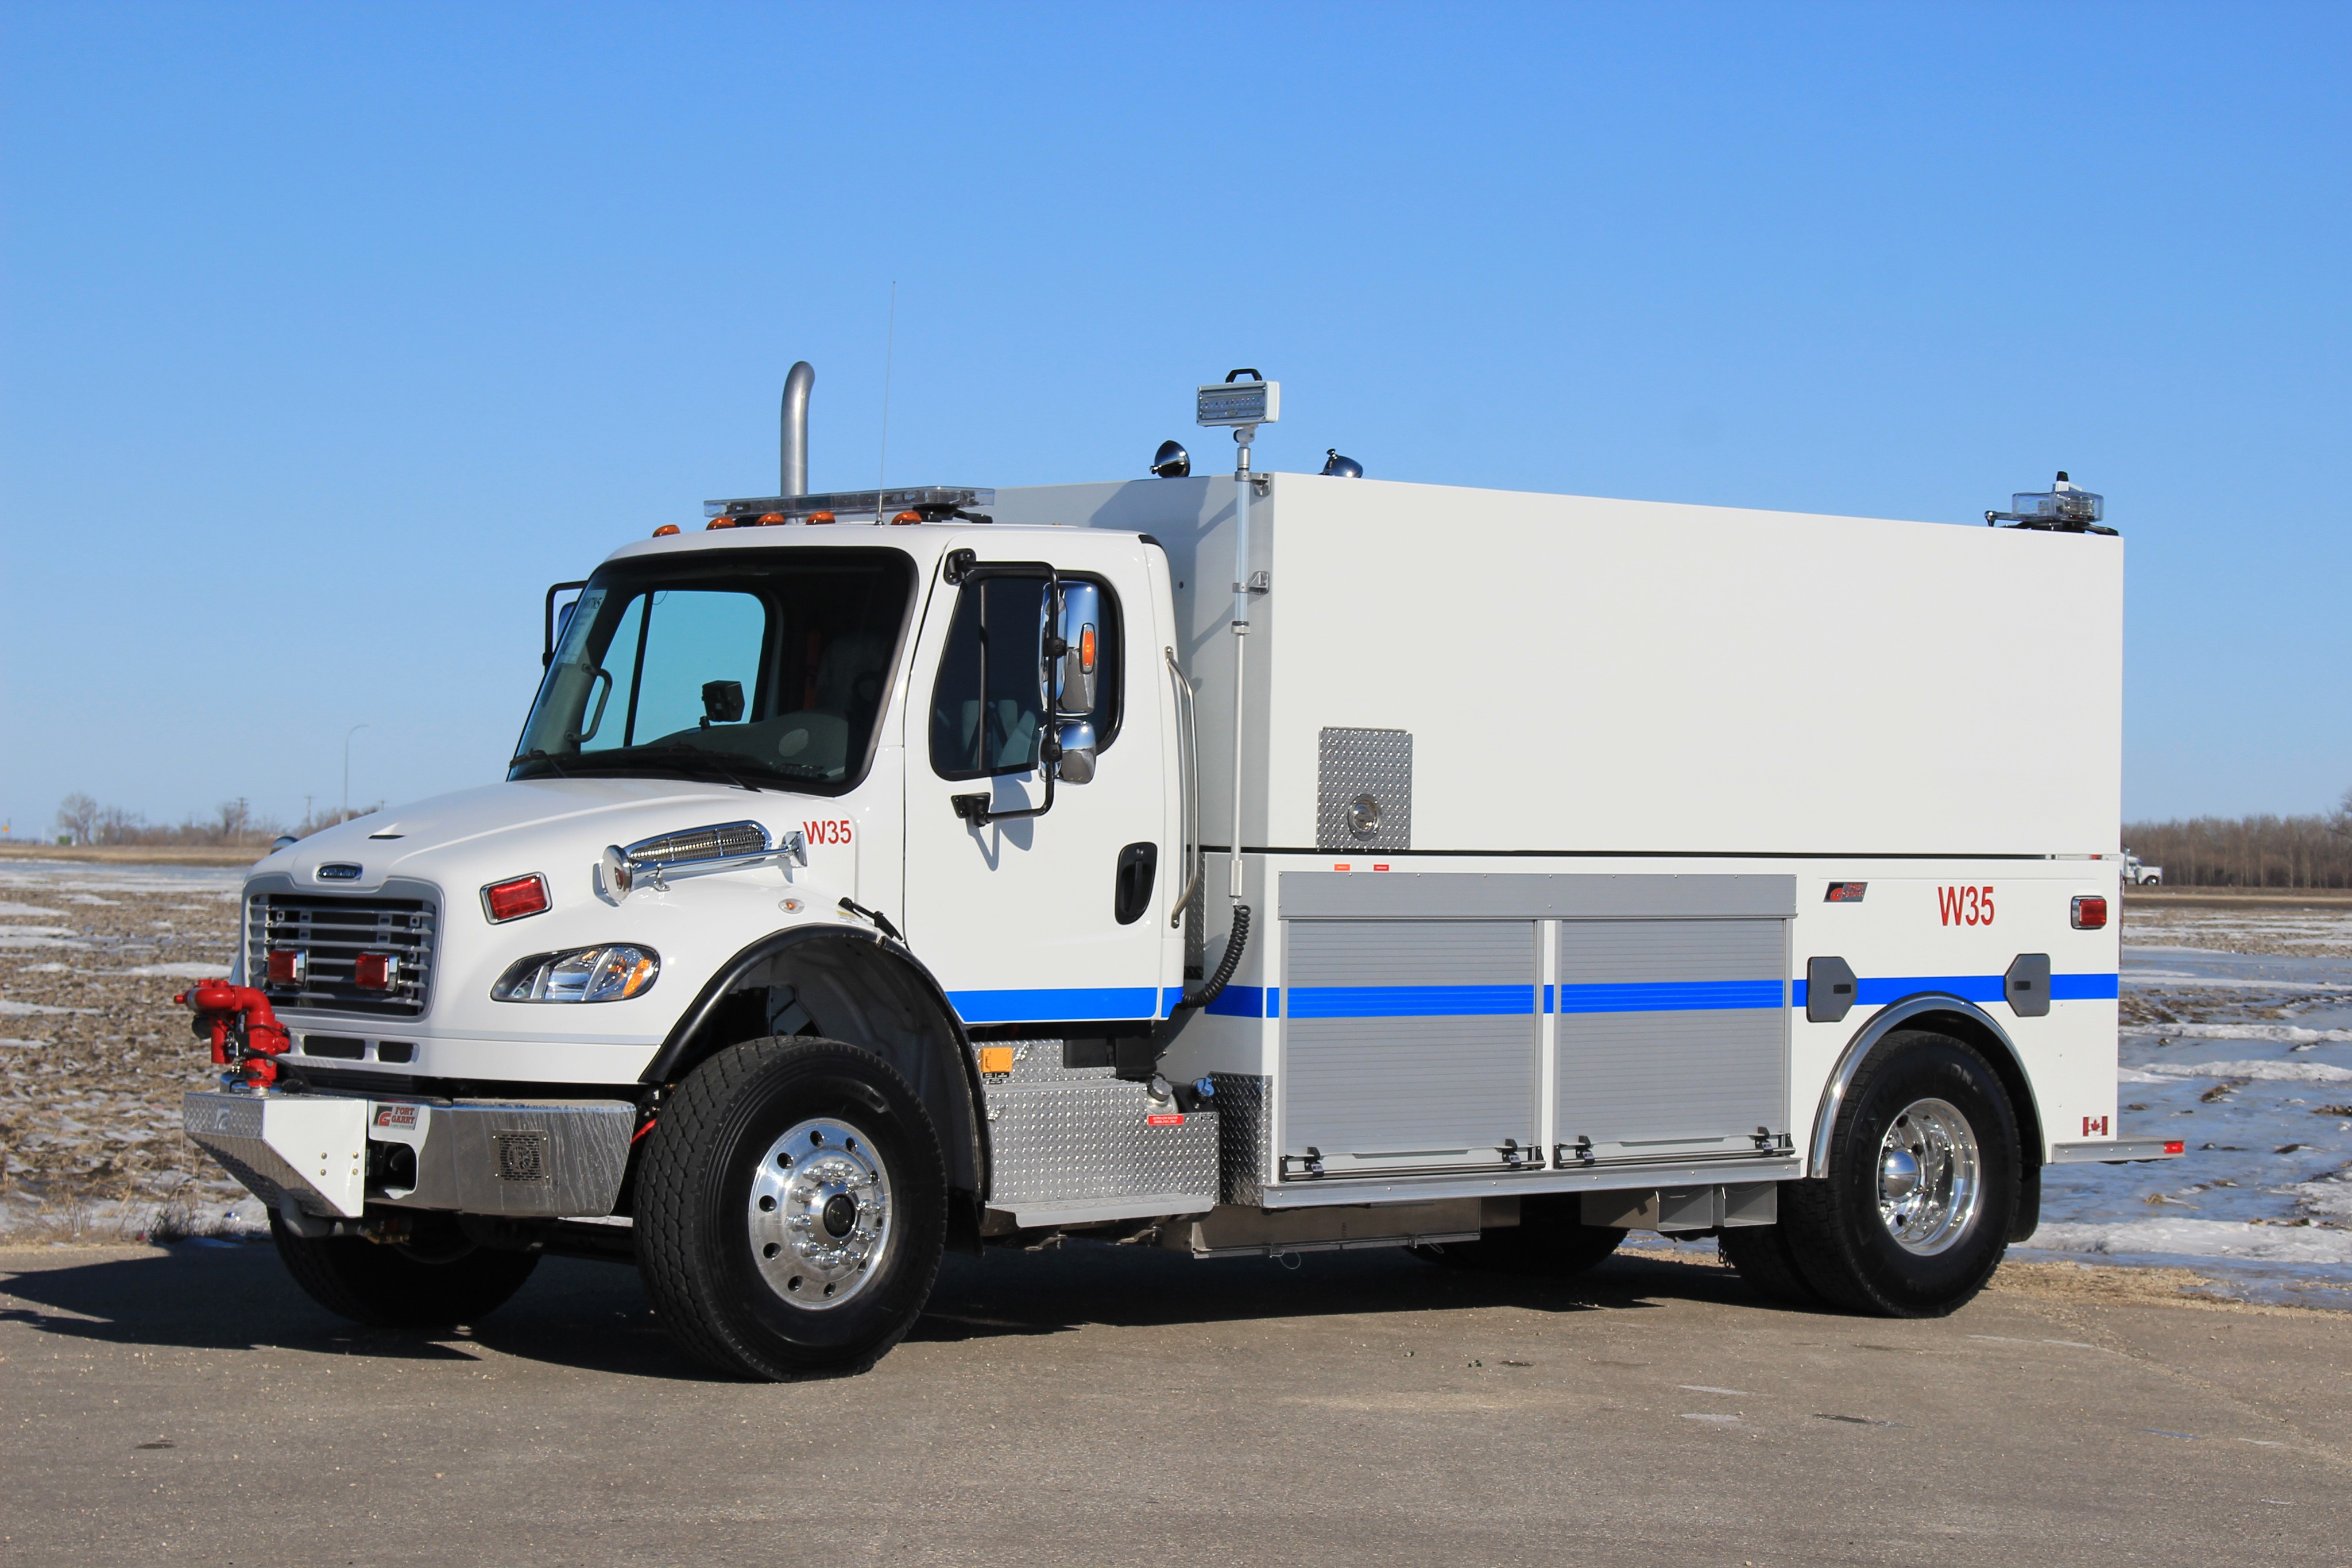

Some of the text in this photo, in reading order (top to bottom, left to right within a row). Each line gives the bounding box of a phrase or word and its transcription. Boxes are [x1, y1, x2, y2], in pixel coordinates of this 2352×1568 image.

[803, 820, 852, 845] W35
[1938, 886, 1995, 926] W35
[395, 1106, 415, 1115] FORT
[391, 1116, 415, 1124] GARRY
